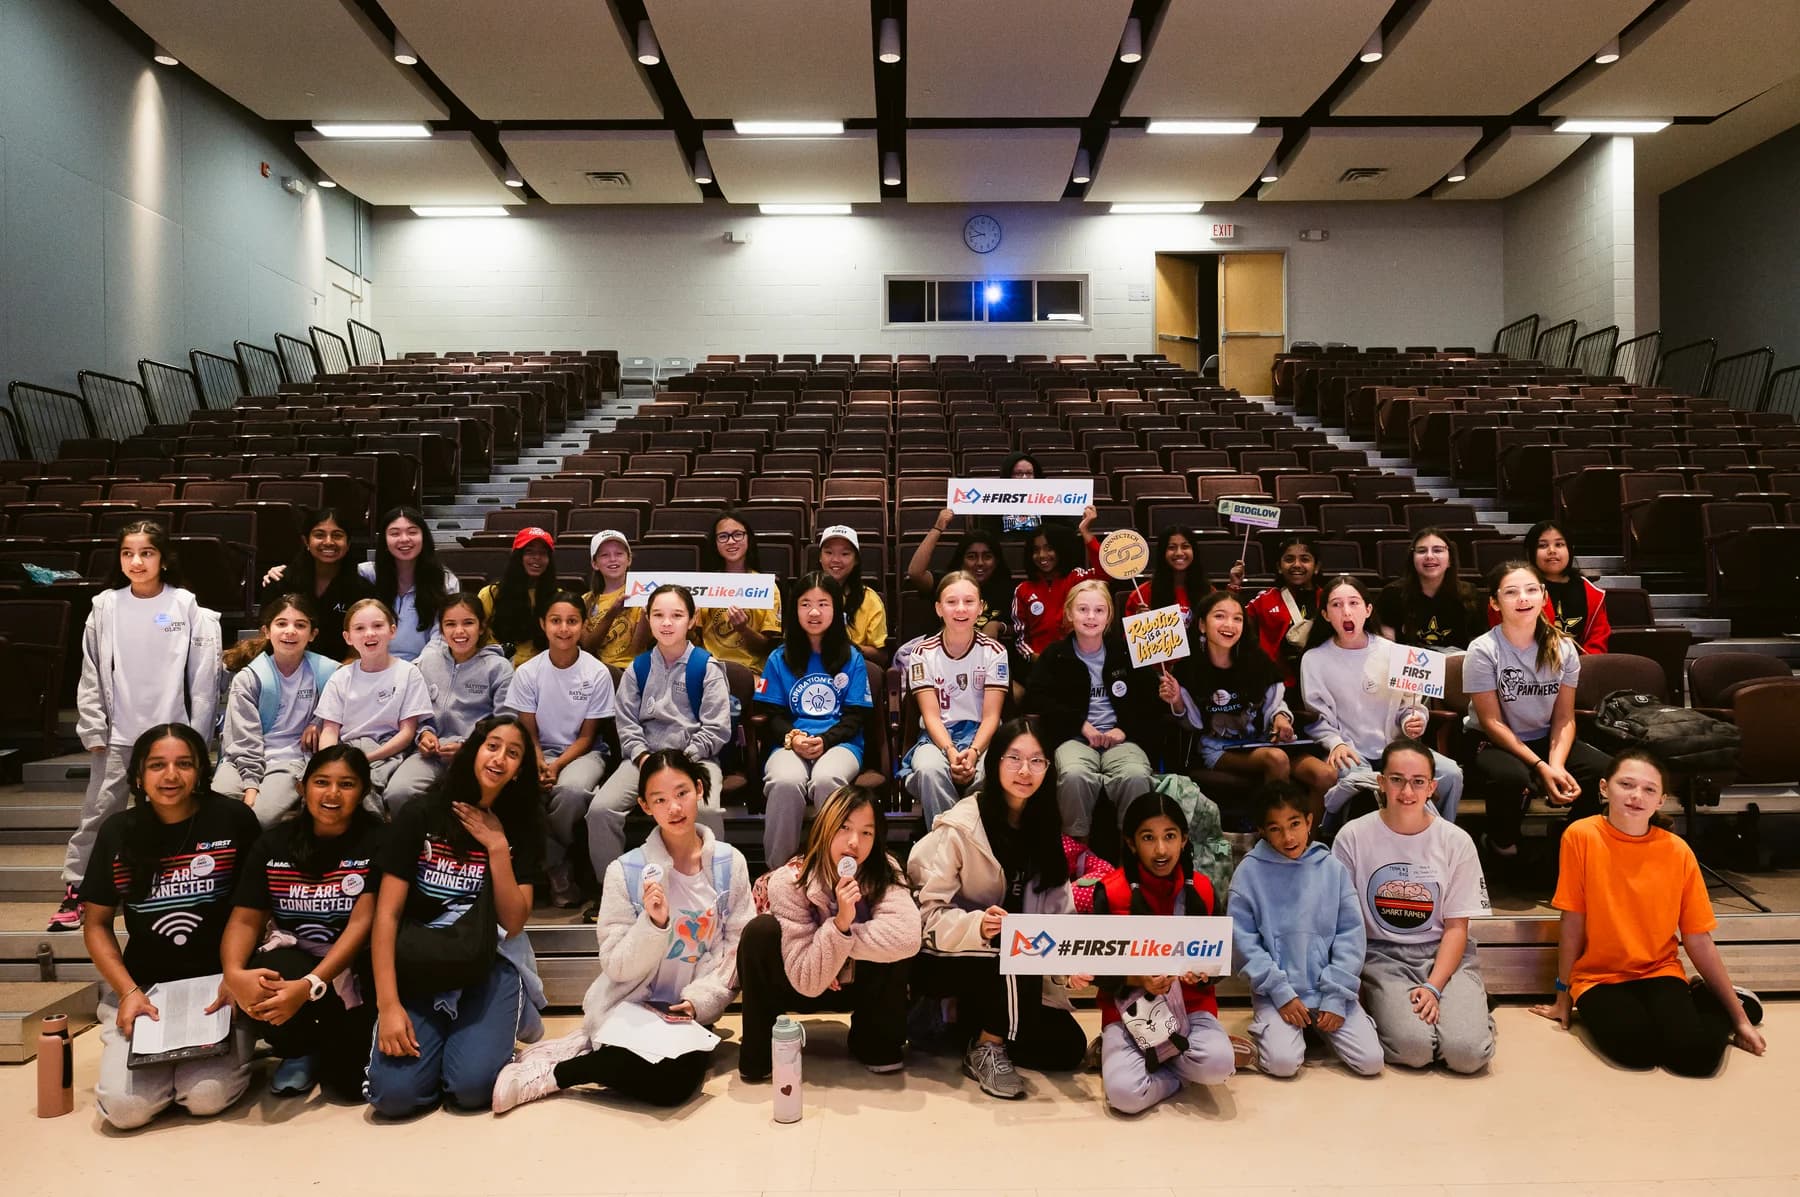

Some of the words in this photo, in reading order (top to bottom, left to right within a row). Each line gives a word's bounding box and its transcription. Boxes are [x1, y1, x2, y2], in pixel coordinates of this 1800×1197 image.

[1213, 224, 1233, 237] EXIT
[1233, 504, 1279, 518] BIOGLOW
[1103, 533, 1139, 552] CONNECTECH
[1127, 611, 1180, 644] Robotics
[1402, 666, 1431, 680] FIRST
[791, 676, 828, 703] OPERATION
[1389, 677, 1443, 696] #LikeAGirl
[1516, 682, 1560, 696] PANTHERS
[437, 857, 458, 874] WE
[458, 863, 485, 879] ARE
[289, 884, 309, 899] WE
[313, 884, 341, 899] ARE
[280, 898, 353, 912] CONNECTED
[1380, 908, 1403, 917] SMART
[1403, 911, 1426, 919] RAMEN
